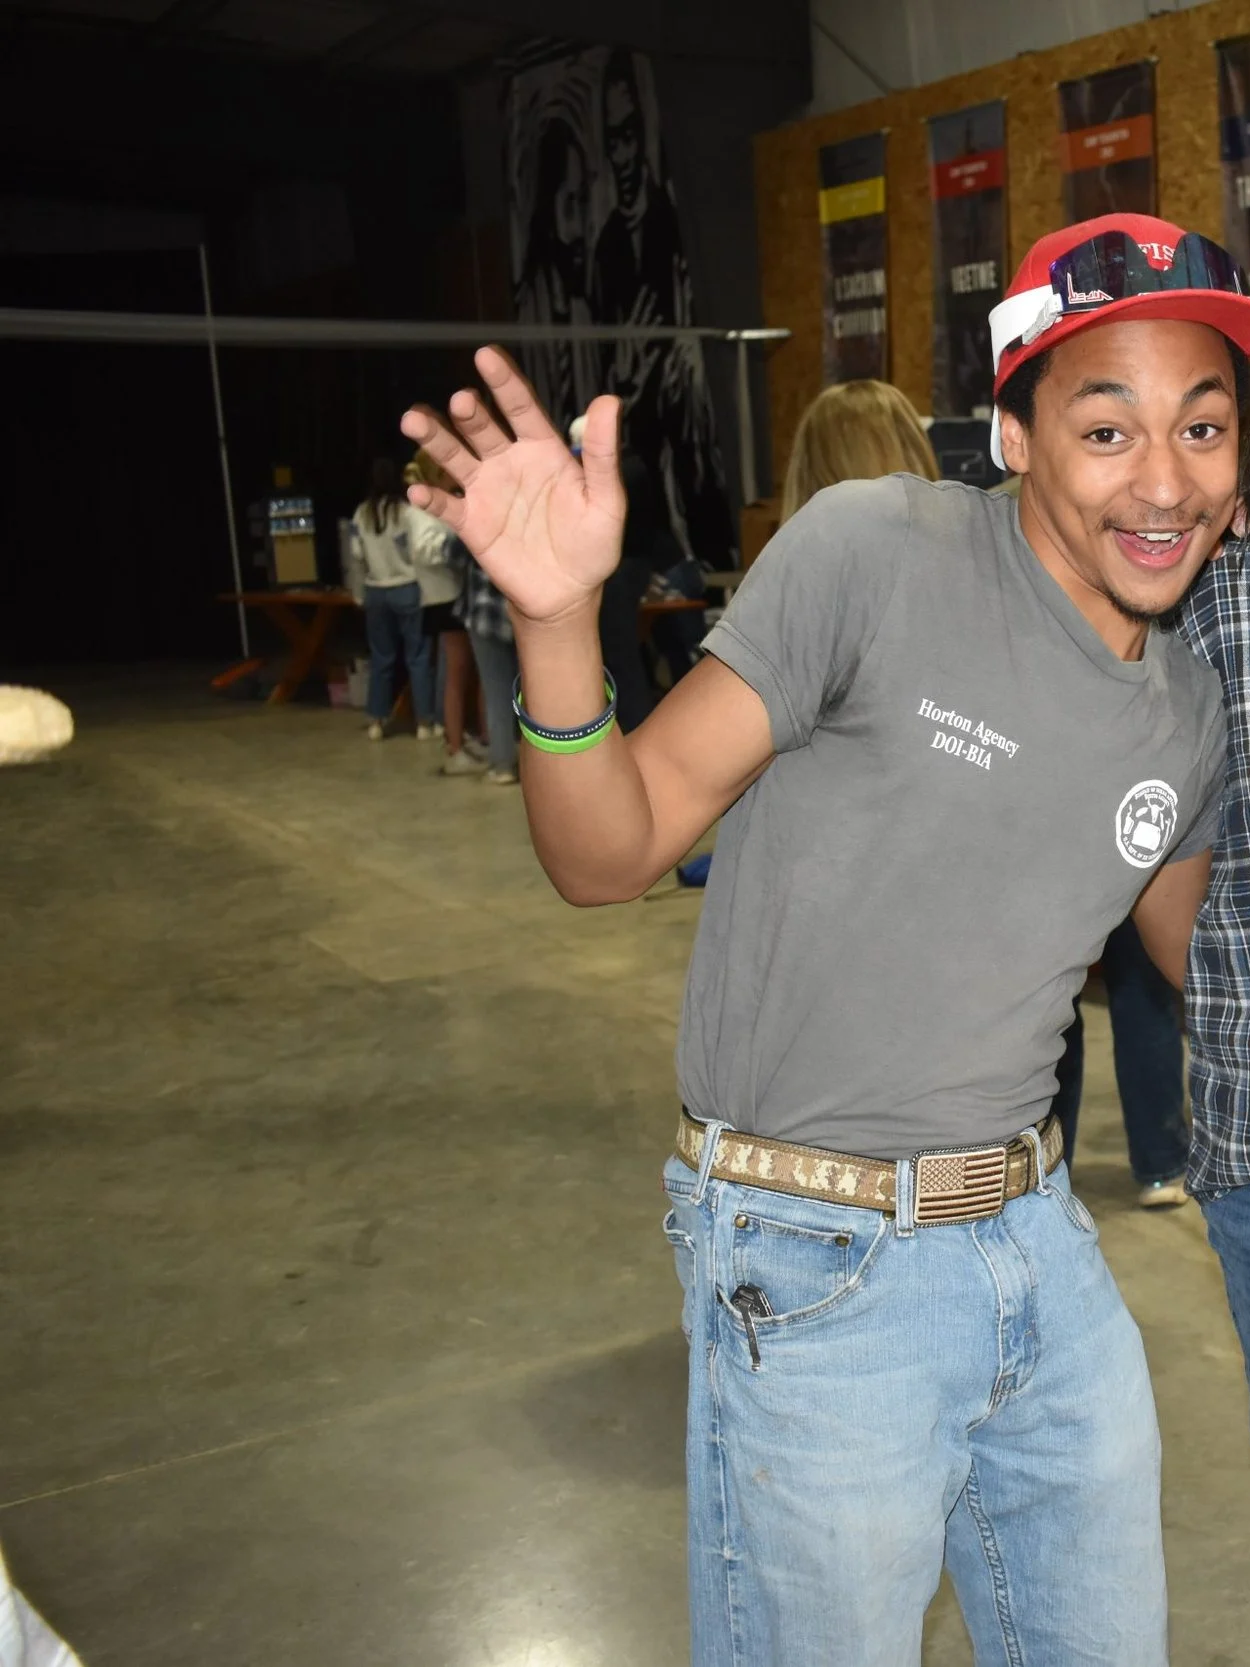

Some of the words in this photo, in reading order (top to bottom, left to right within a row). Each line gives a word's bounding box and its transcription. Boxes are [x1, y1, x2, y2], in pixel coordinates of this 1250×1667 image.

[917, 698, 972, 733] Horton
[972, 721, 1020, 759] Agency
[930, 731, 992, 770] DOI-BIA
